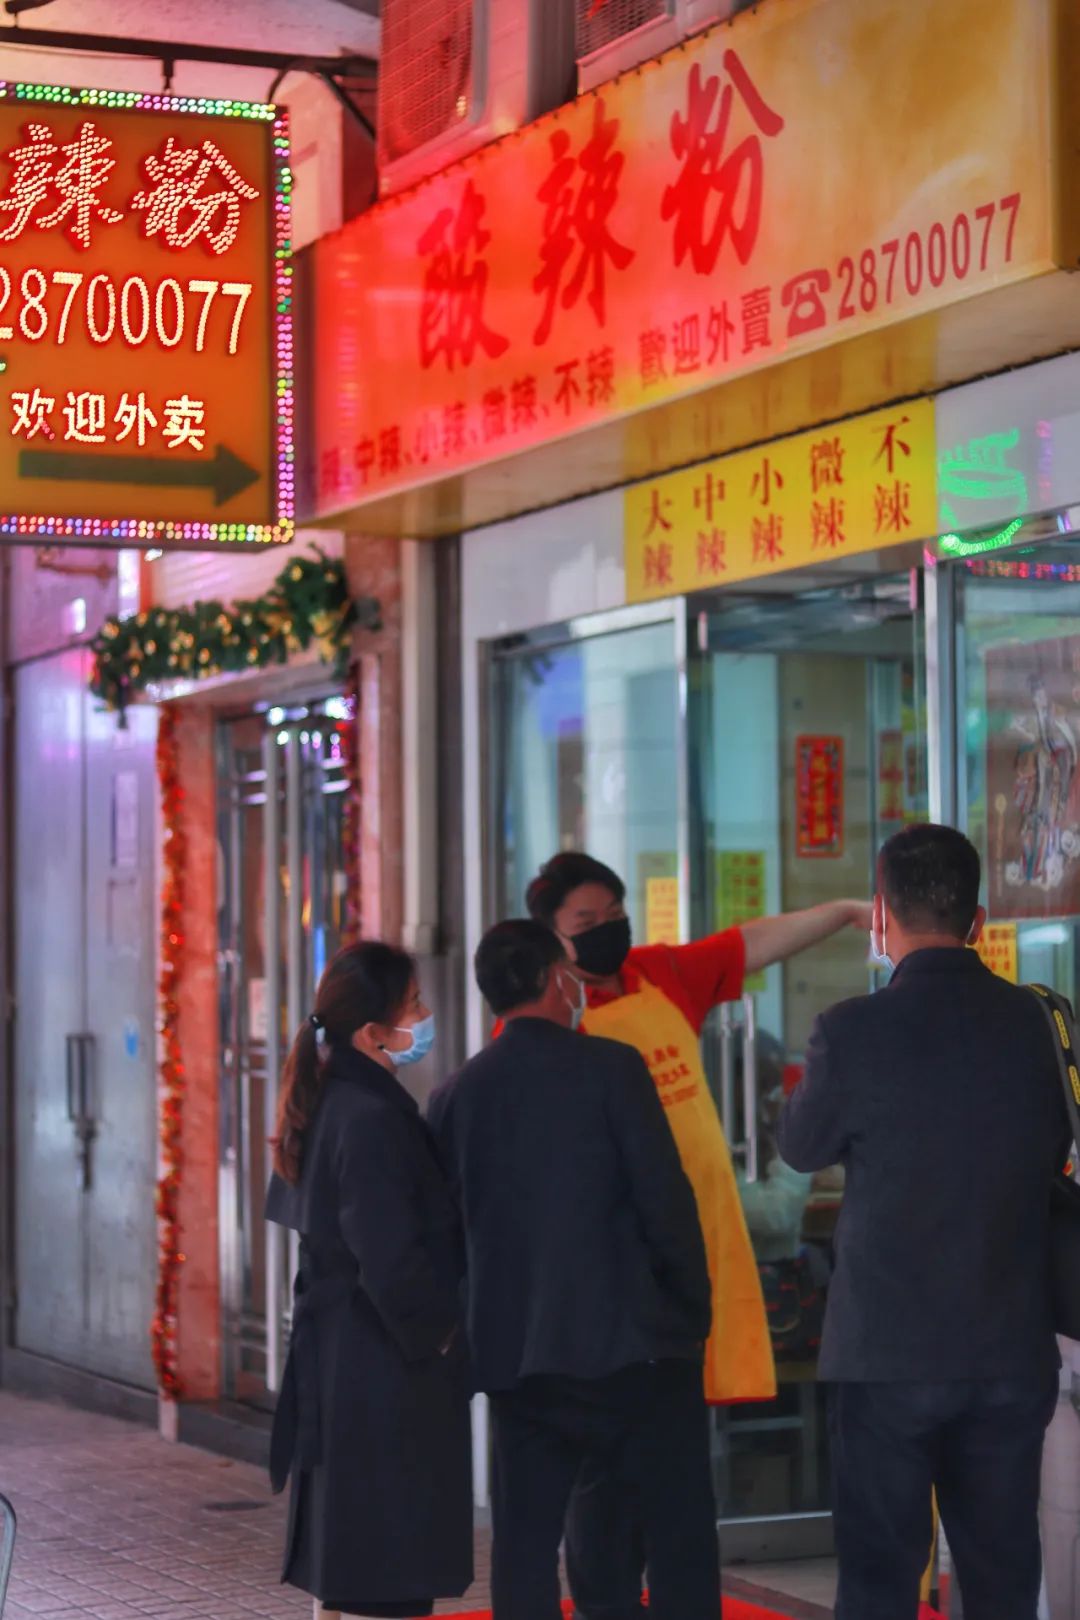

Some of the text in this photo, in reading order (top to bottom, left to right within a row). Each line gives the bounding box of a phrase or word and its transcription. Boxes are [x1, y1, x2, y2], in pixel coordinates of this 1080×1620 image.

[416, 48, 785, 371] 酸辣粉
[637, 285, 772, 387] 歡迎外賣
[836, 192, 1022, 321] 28700077
[10, 388, 206, 451] 欢迎外卖
[692, 472, 727, 577] 中辣
[749, 457, 785, 564] 小辣
[808, 436, 847, 550] 微辣
[871, 416, 913, 534] 不辣
[642, 488, 674, 589] 大辣
